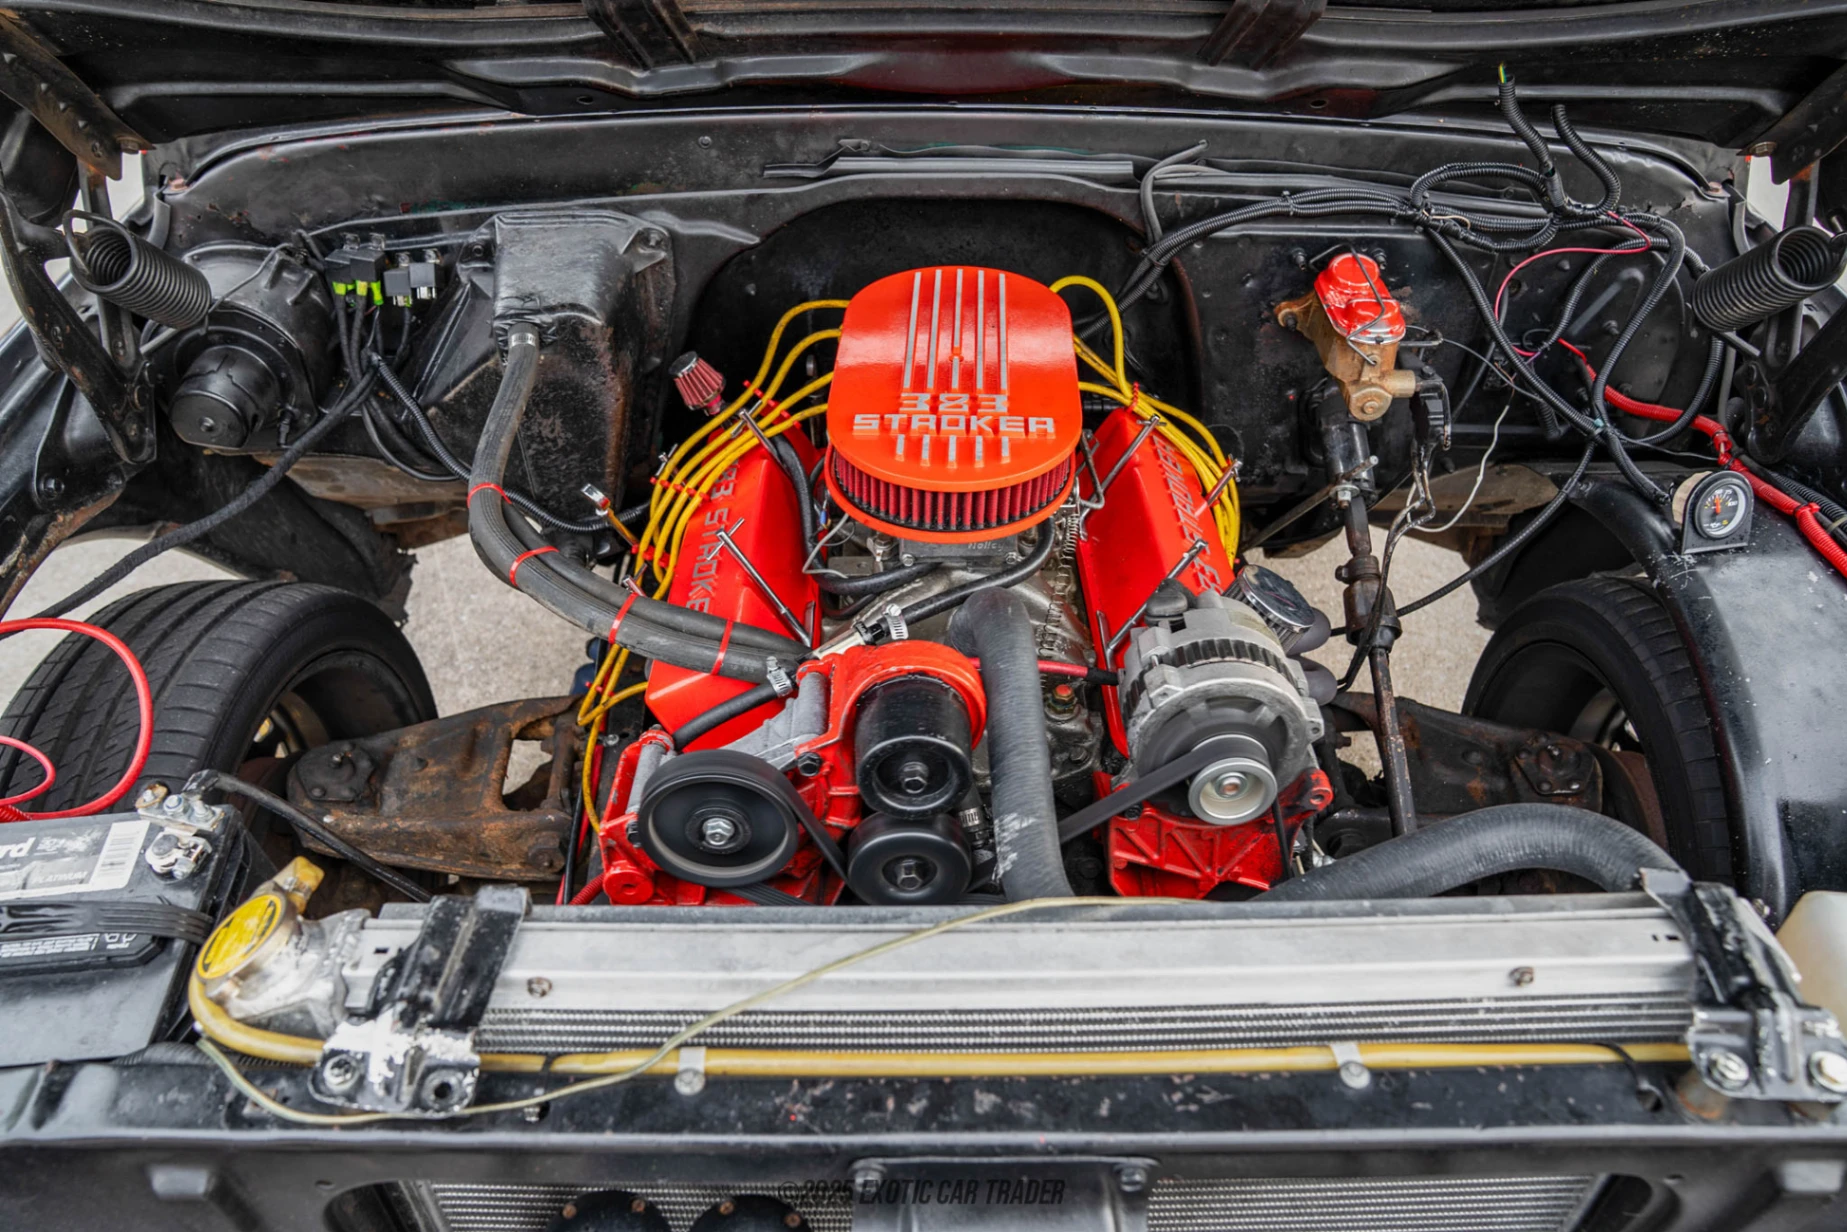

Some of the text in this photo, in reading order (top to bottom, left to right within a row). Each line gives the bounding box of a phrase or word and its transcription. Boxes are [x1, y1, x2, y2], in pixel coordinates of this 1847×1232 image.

[900, 393, 1008, 413] 383
[853, 414, 1056, 433] STROKER
[686, 508, 728, 613] STROKE
